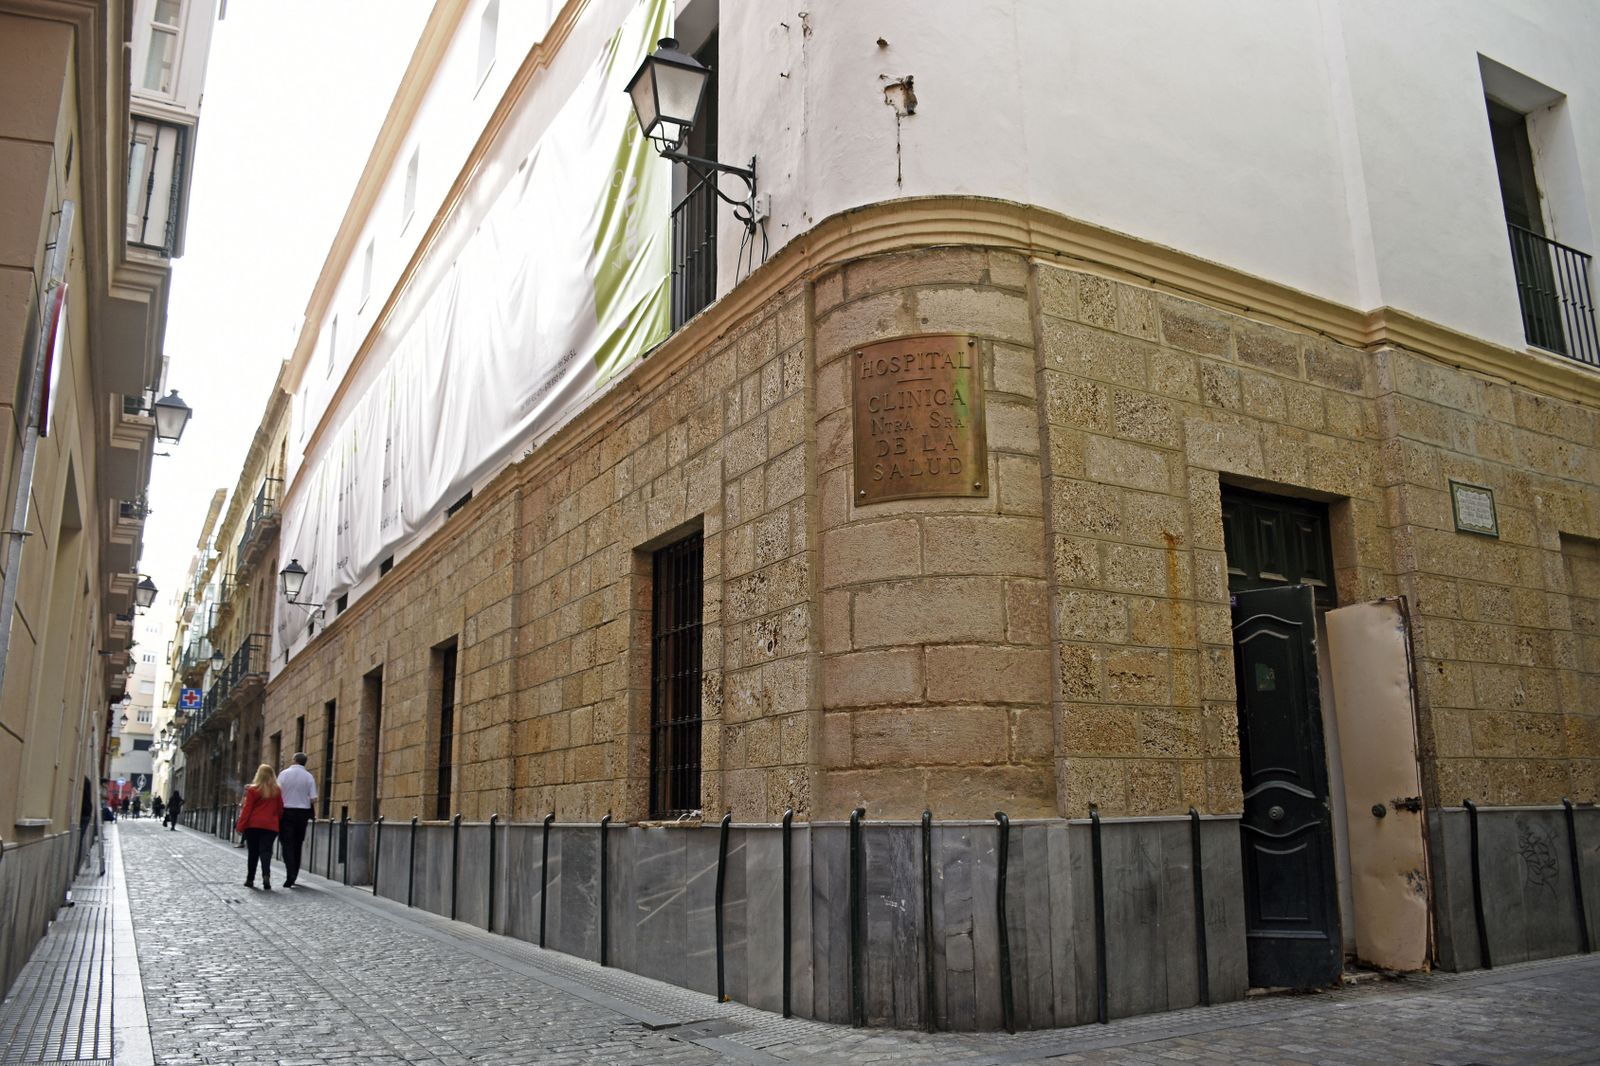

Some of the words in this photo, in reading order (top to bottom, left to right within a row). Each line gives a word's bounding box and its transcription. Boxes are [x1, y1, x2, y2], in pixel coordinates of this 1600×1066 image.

[861, 351, 971, 380] HOSPITAL
[869, 388, 966, 413] CLINICA
[876, 437, 907, 458] DE
[922, 434, 959, 452] LA
[872, 457, 962, 482] SALUD
